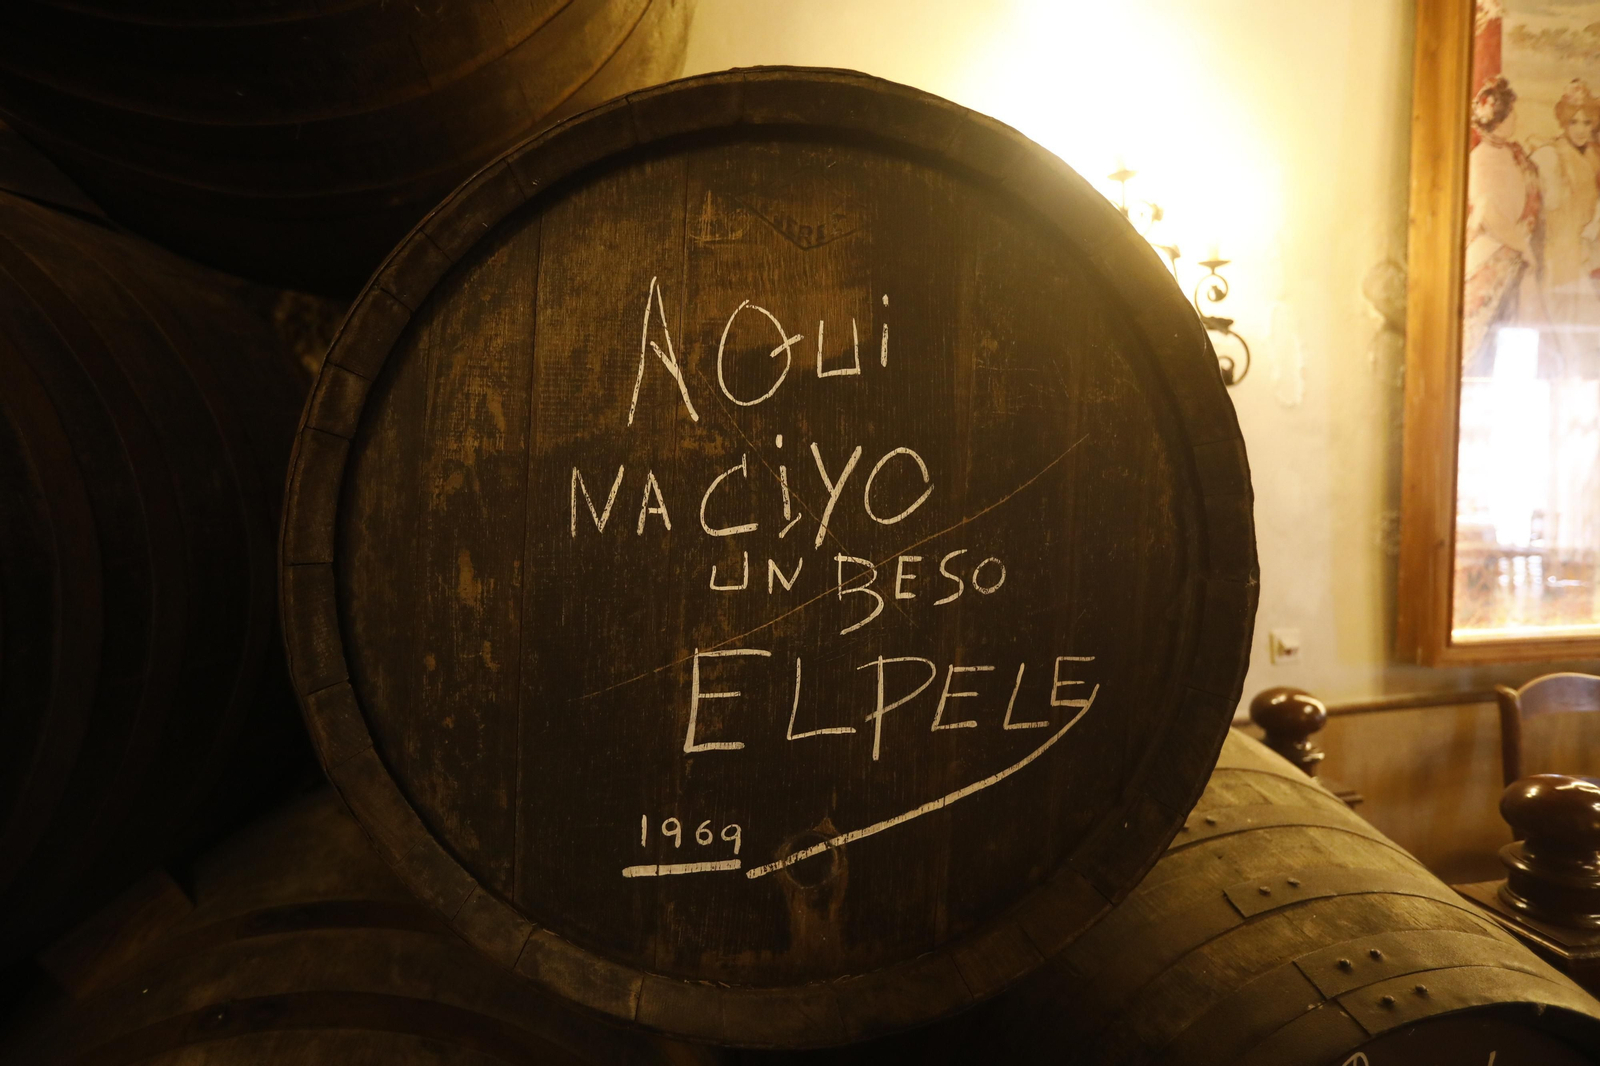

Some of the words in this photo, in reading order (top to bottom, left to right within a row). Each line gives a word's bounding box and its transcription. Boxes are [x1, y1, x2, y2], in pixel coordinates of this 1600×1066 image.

[709, 551, 804, 595] UN
[833, 549, 1007, 636] BESO
[640, 814, 743, 855] 1969
